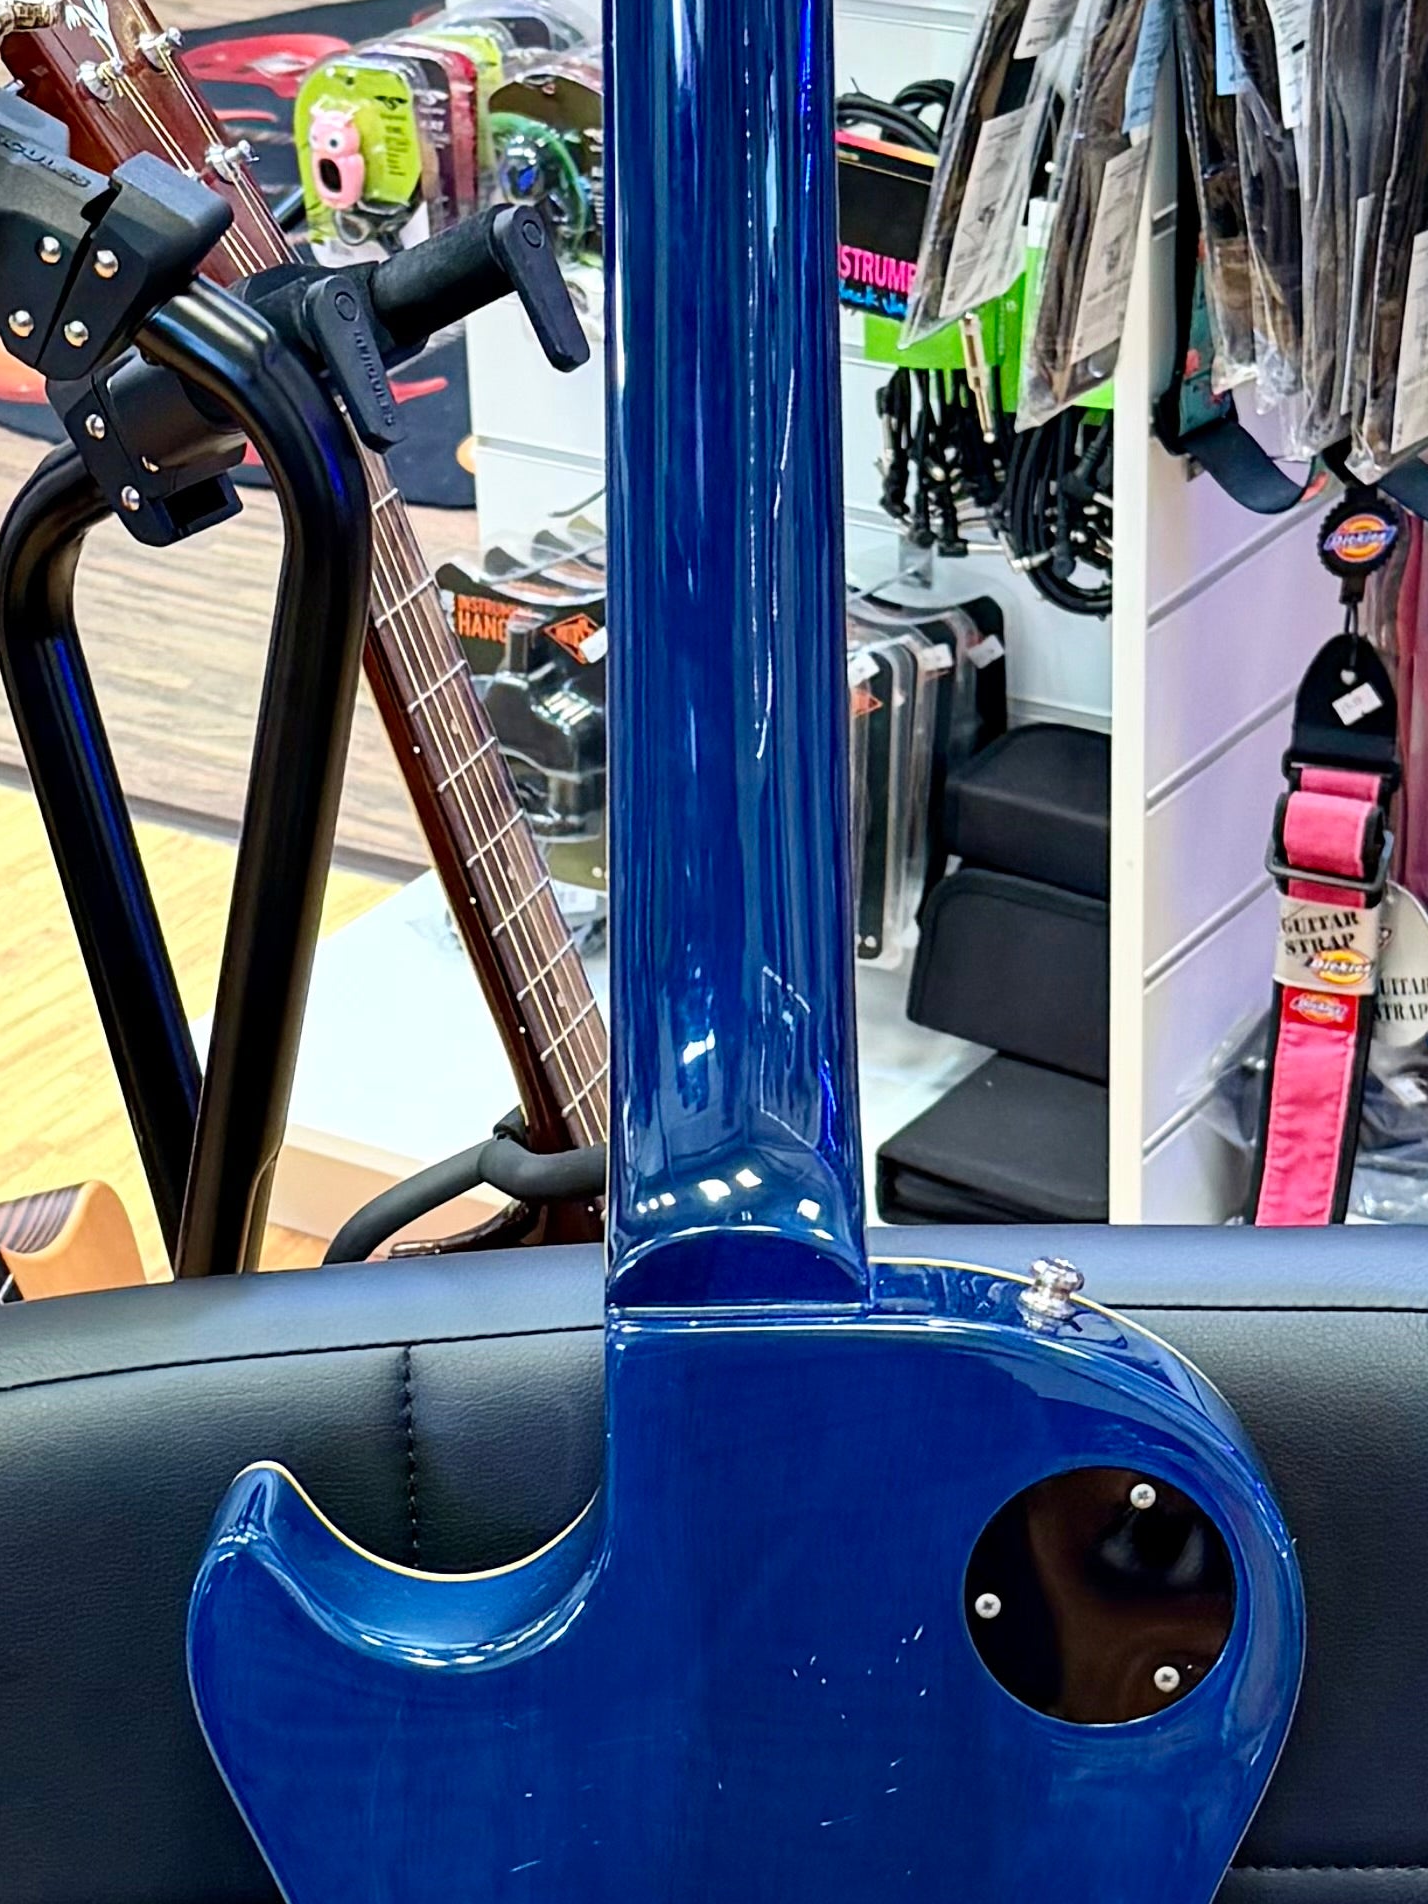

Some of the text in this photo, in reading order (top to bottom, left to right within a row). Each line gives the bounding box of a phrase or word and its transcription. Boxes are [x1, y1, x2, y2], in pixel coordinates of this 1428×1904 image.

[1323, 526, 1396, 550] Dickies
[1280, 910, 1359, 937] GUITAR
[1285, 932, 1355, 956] STRAP
[1304, 954, 1373, 980] Dickies
